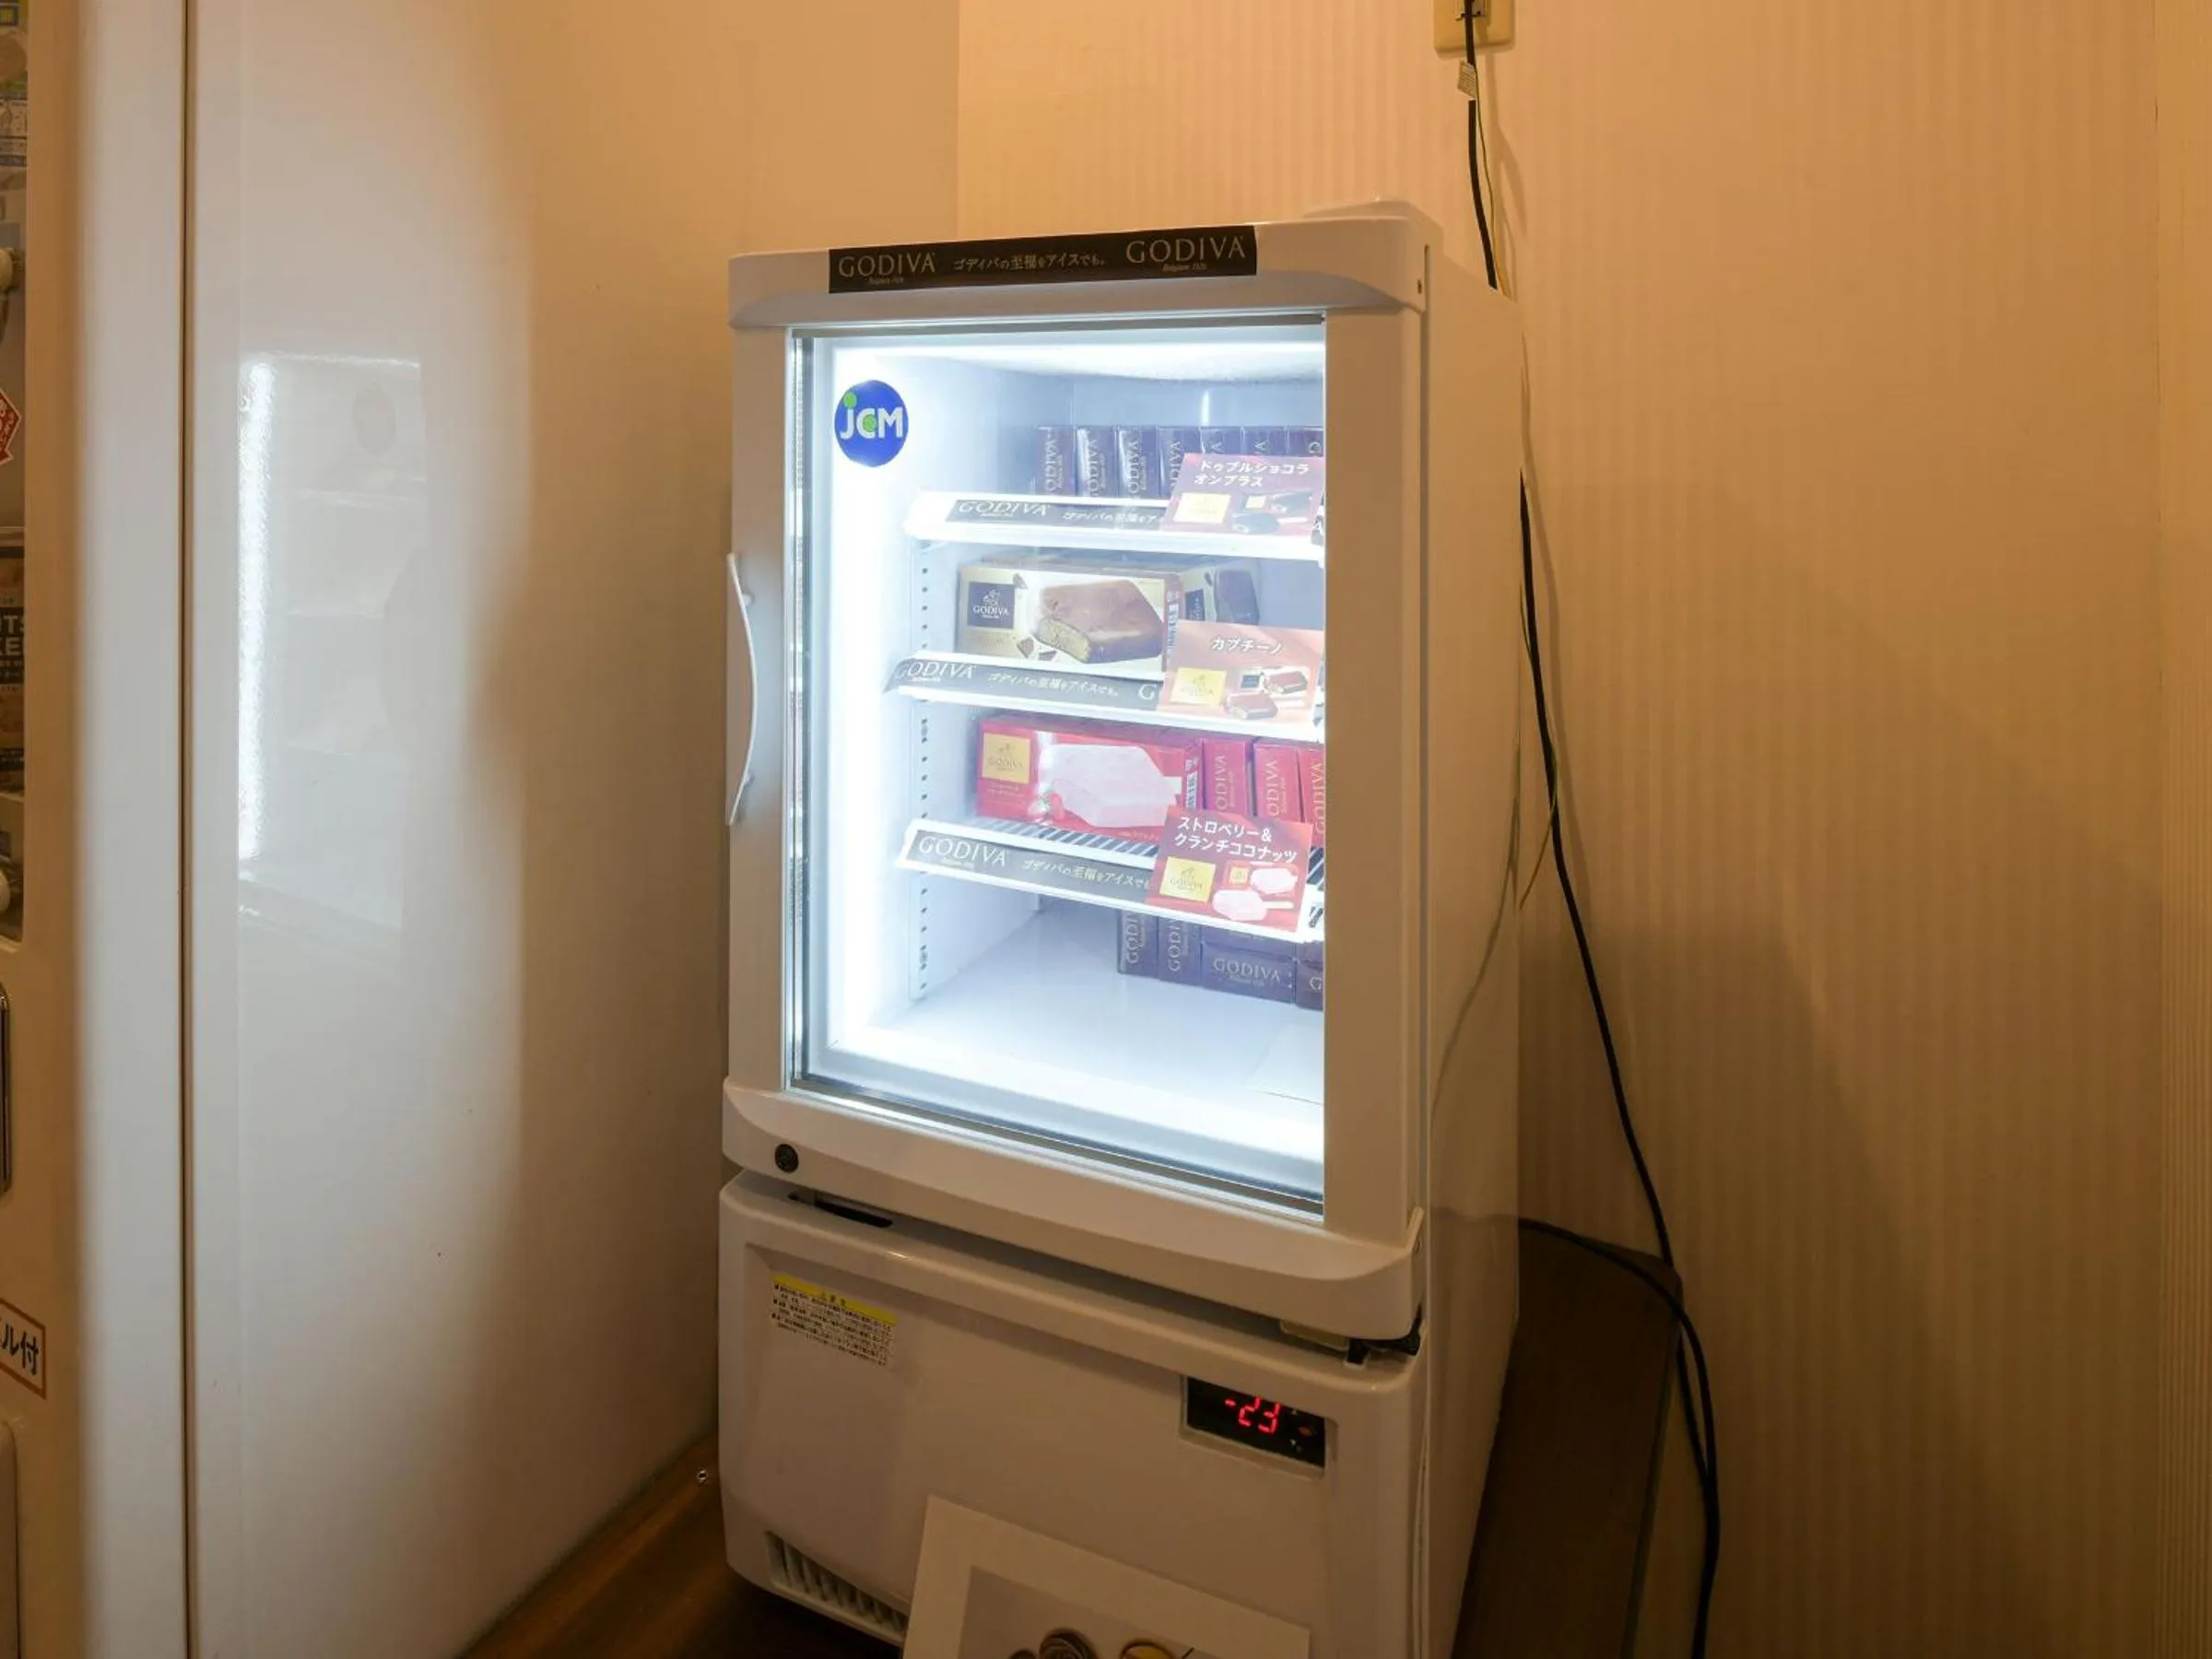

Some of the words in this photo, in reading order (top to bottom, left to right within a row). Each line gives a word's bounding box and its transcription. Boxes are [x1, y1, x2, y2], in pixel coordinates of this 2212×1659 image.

[838, 252, 935, 277] GODIVA
[1125, 237, 1246, 265] GODIVA
[840, 396, 903, 440] JCM
[959, 500, 1048, 517] GODIVA
[1212, 636, 1282, 655] カプチーノ
[1178, 816, 1273, 843] ストロベリー&
[919, 835, 1006, 867] GODIVA
[1174, 831, 1298, 862] クランチココナッツ
[1213, 959, 1281, 983] GODIVA
[1, 1323, 39, 1376] ル付
[1225, 1394, 1281, 1434] -23
